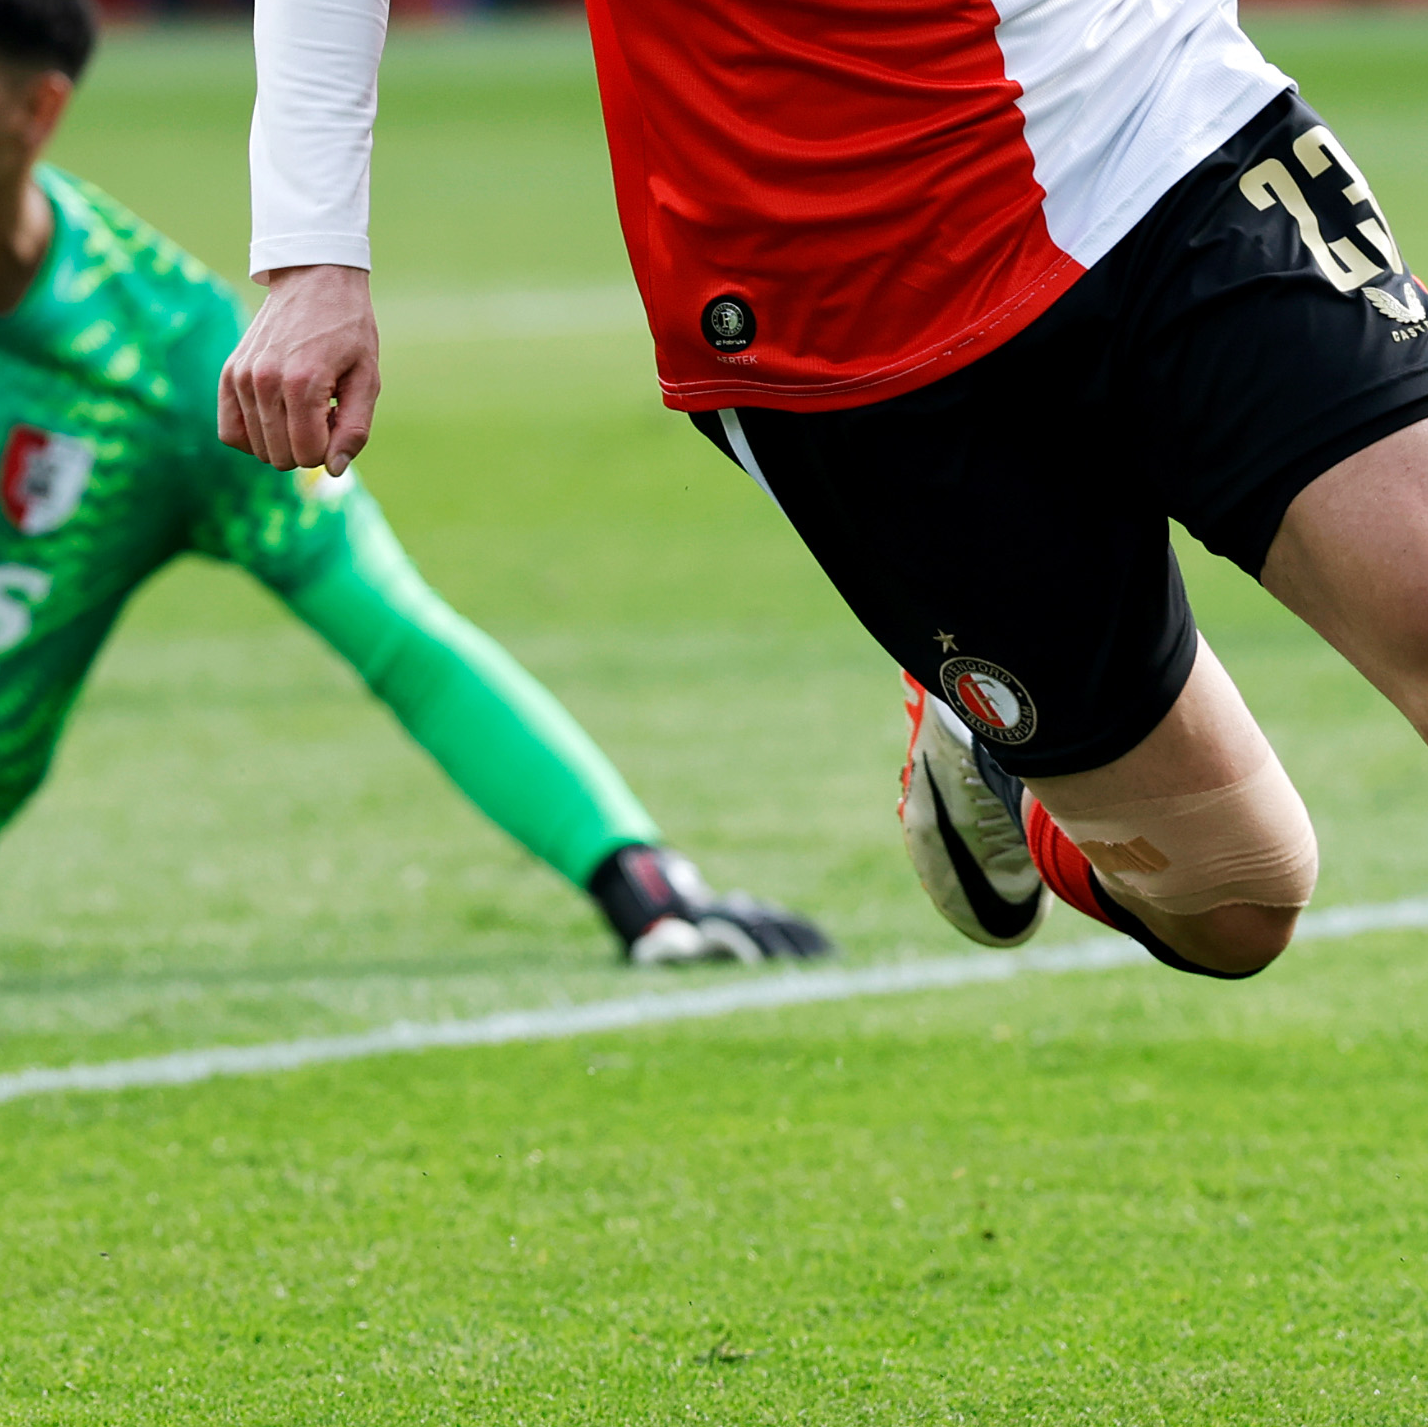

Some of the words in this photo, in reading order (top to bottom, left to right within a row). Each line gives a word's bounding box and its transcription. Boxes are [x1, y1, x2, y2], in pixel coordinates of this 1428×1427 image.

[1238, 124, 1404, 293] 23
[946, 661, 1011, 690] FEYENOORD
[966, 706, 1032, 741] ROTTERDAM
